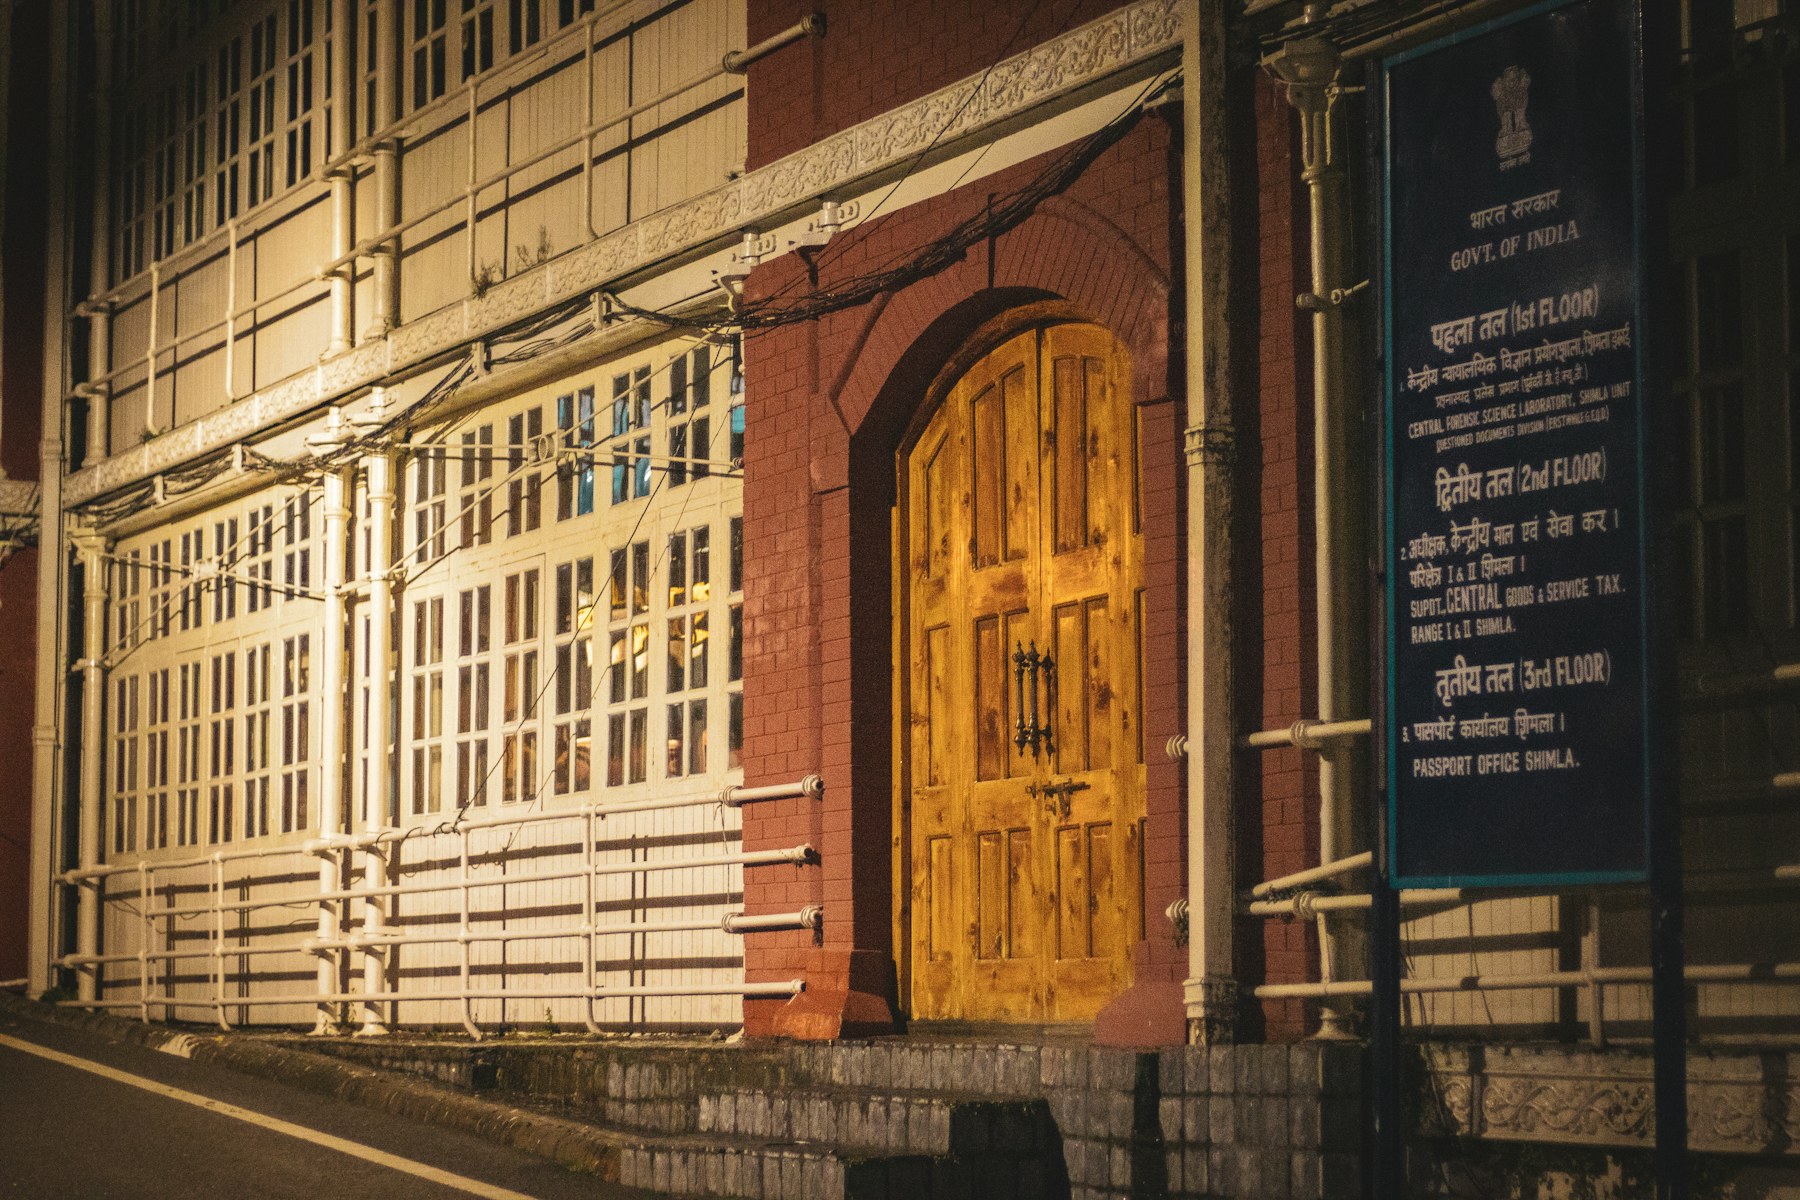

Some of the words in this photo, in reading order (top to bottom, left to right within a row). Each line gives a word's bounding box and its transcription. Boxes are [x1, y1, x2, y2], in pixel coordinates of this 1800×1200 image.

[1470, 204, 1508, 230] भारत
[1512, 189, 1561, 219] सरकार
[1451, 243, 1497, 272] GOVT.
[1500, 235, 1520, 258] OF
[1526, 220, 1580, 251] INDIA
[1430, 315, 1475, 353] पहला
[1479, 308, 1509, 341] तल
[1511, 300, 1537, 336] (1st
[1538, 283, 1600, 326] FLOOR)
[1407, 364, 1439, 393] केन्द्रीय
[1500, 347, 1532, 373] विज्ञान
[1408, 417, 1445, 439] CENTRAL
[1446, 410, 1480, 431] FORENSIC
[1482, 402, 1517, 425] SCIENCE
[1579, 386, 1610, 406] SHIMLA
[1611, 381, 1632, 398] UNIT
[1436, 433, 1474, 453] QUESTIONED
[1476, 426, 1515, 444] DOCUMENTS
[1517, 419, 1545, 436] DIVISION
[1435, 462, 1483, 512] द्वितीय
[1485, 466, 1515, 498] तल
[1516, 454, 1549, 496] (2nd
[1553, 446, 1606, 487] FLOOR)
[1450, 516, 1491, 555] केन्द्रीय
[1494, 524, 1515, 546] माल
[1521, 515, 1539, 543] एवं
[1547, 509, 1574, 539] सेवा
[1582, 509, 1608, 533] कर
[1456, 567, 1464, 582] &
[1481, 553, 1515, 581] शिमला
[1446, 582, 1502, 613] CENTRAL
[1506, 585, 1535, 607] GOODS
[1537, 588, 1545, 603] &
[1546, 578, 1589, 602] SERVICE
[1595, 574, 1626, 595] TAX.
[1411, 623, 1444, 644] RANGE
[1454, 624, 1461, 639] &
[1476, 615, 1516, 636] SHIMLA.
[1435, 654, 1481, 707] तृतीय
[1485, 662, 1515, 694] तल
[1519, 656, 1552, 694] (3rd
[1555, 648, 1611, 686] FLOOR)
[1413, 715, 1456, 742] पासपोर्ट
[1459, 712, 1510, 738] कार्यालय
[1514, 708, 1555, 740] शिमला
[1413, 756, 1473, 778] PASSPORT
[1477, 752, 1520, 775] OFFICE
[1525, 748, 1580, 771] SHIMLA.
